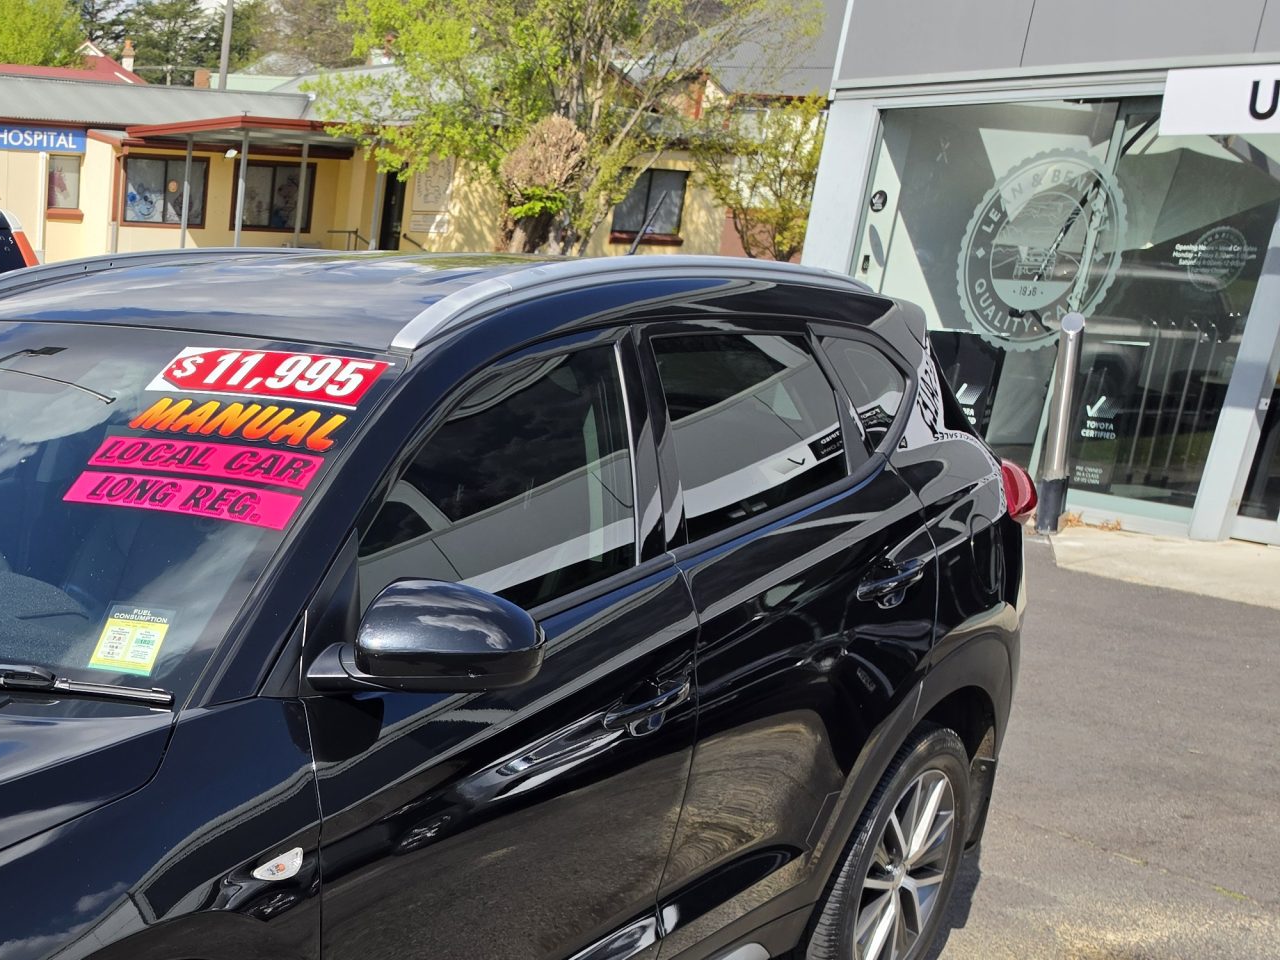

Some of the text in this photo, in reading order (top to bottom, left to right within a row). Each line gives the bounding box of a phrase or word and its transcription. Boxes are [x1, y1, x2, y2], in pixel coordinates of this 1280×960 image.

[975, 278, 1032, 332] QUALITY
[128, 397, 348, 451] MANUAL
[1081, 428, 1116, 440] CERTIFIED
[1086, 420, 1114, 430] TOYOTA
[95, 439, 315, 484] LOCAL CAR
[87, 474, 182, 508] LONG
[114, 612, 168, 623] CONSUMPTION
[133, 608, 152, 616] FUEL
